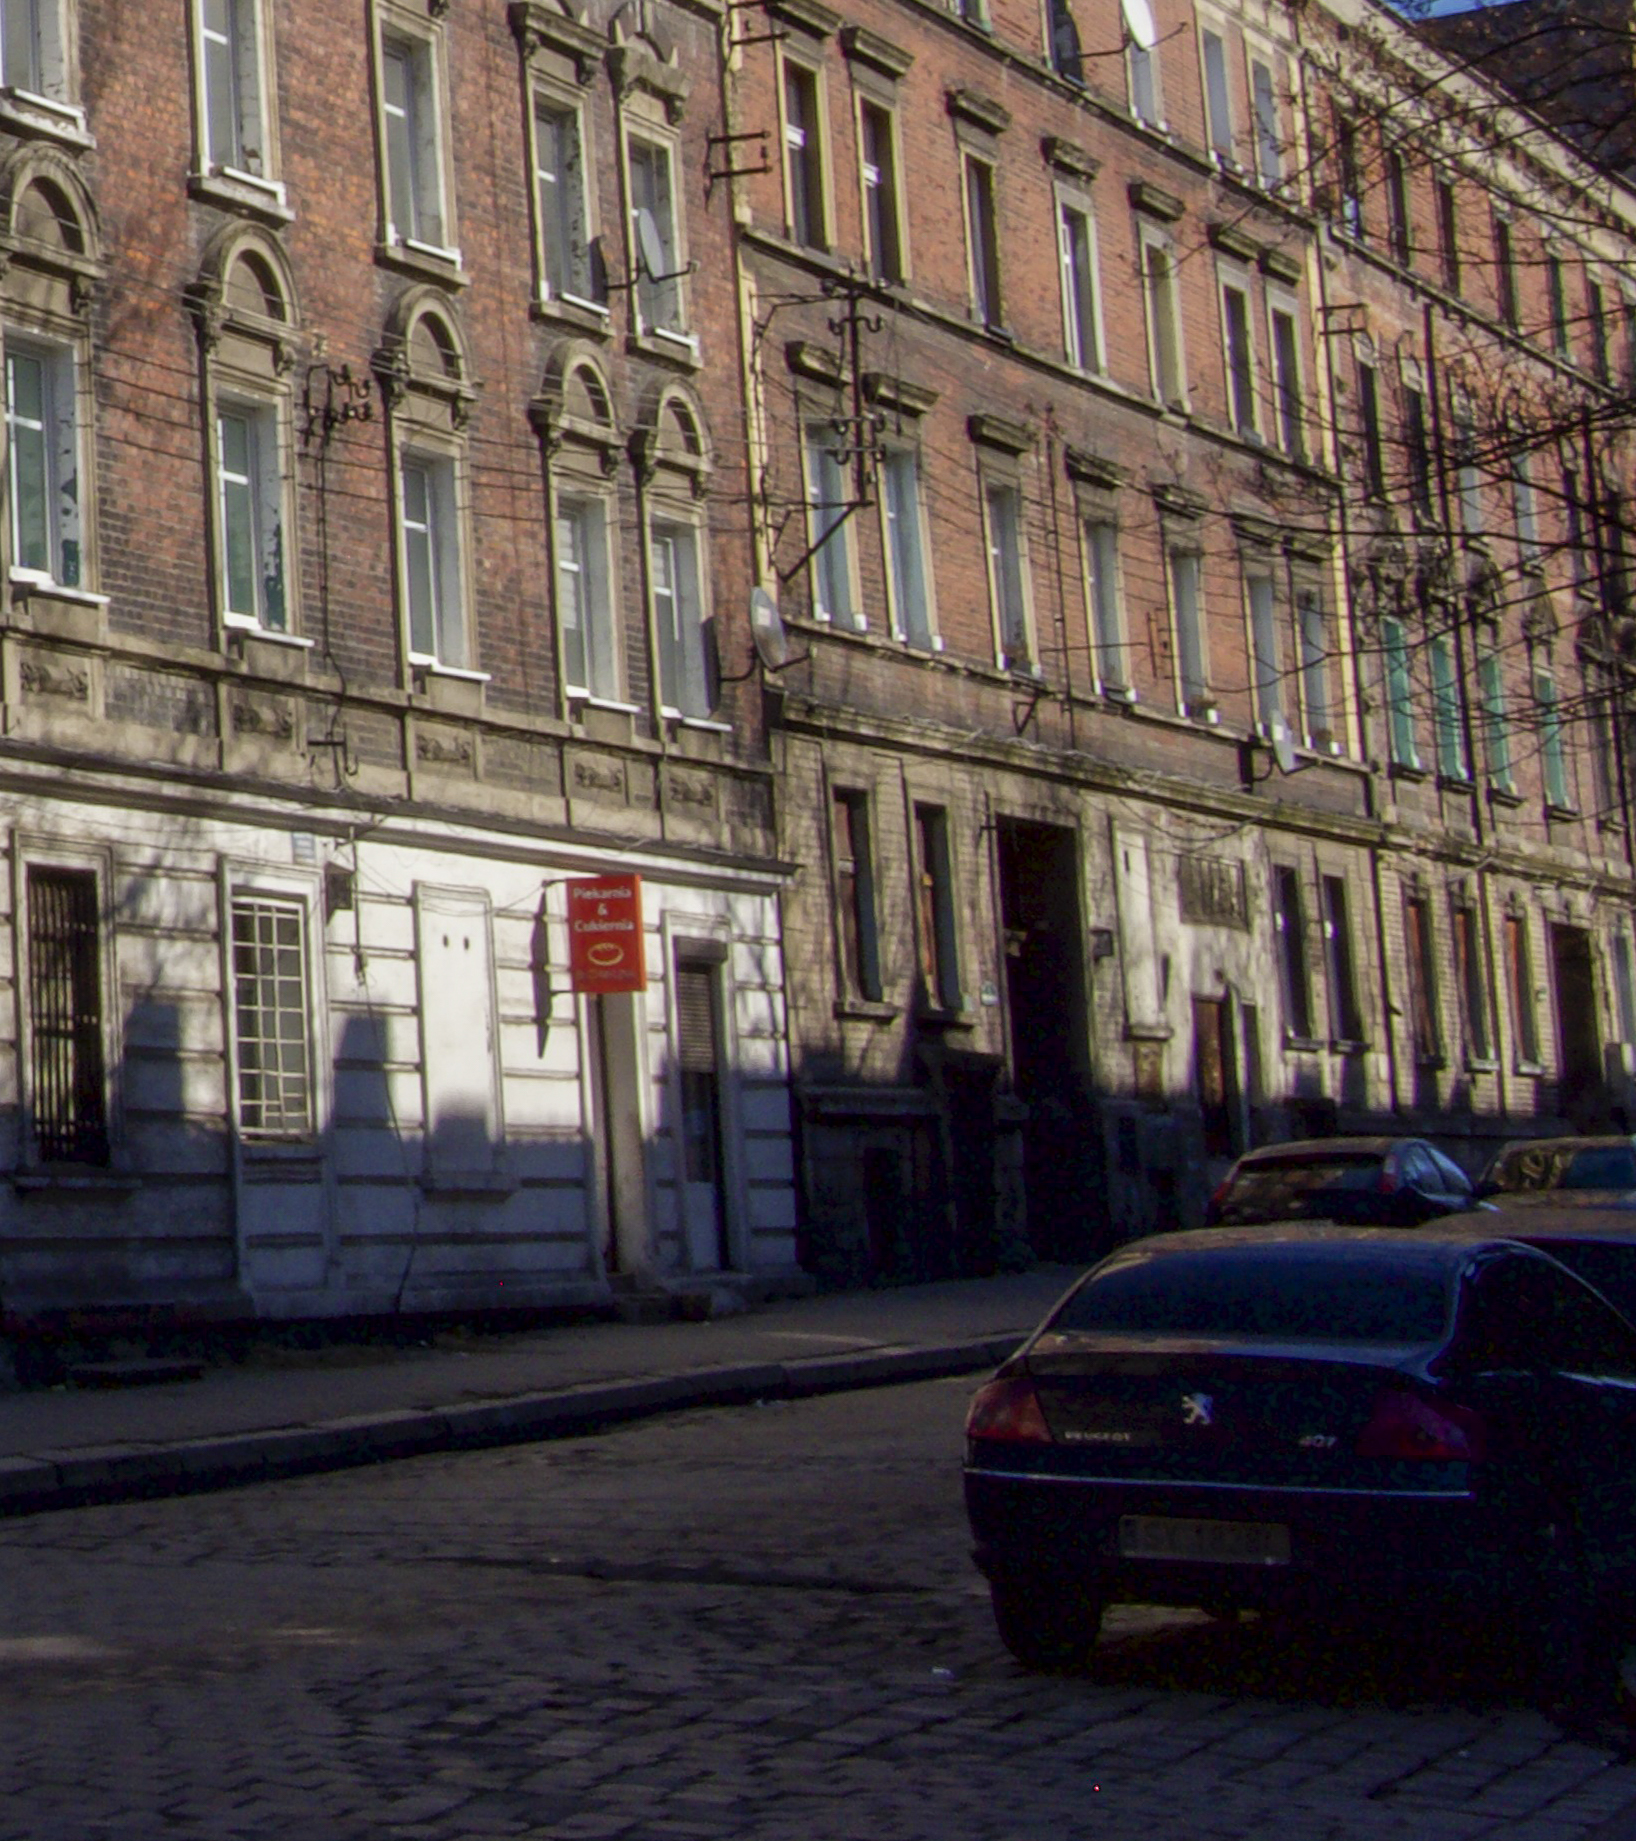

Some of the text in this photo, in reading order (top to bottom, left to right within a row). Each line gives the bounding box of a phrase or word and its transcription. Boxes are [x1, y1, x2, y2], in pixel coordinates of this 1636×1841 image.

[573, 886, 632, 900] Piekarnia
[597, 903, 608, 915] &
[574, 919, 634, 932] Cukiernia
